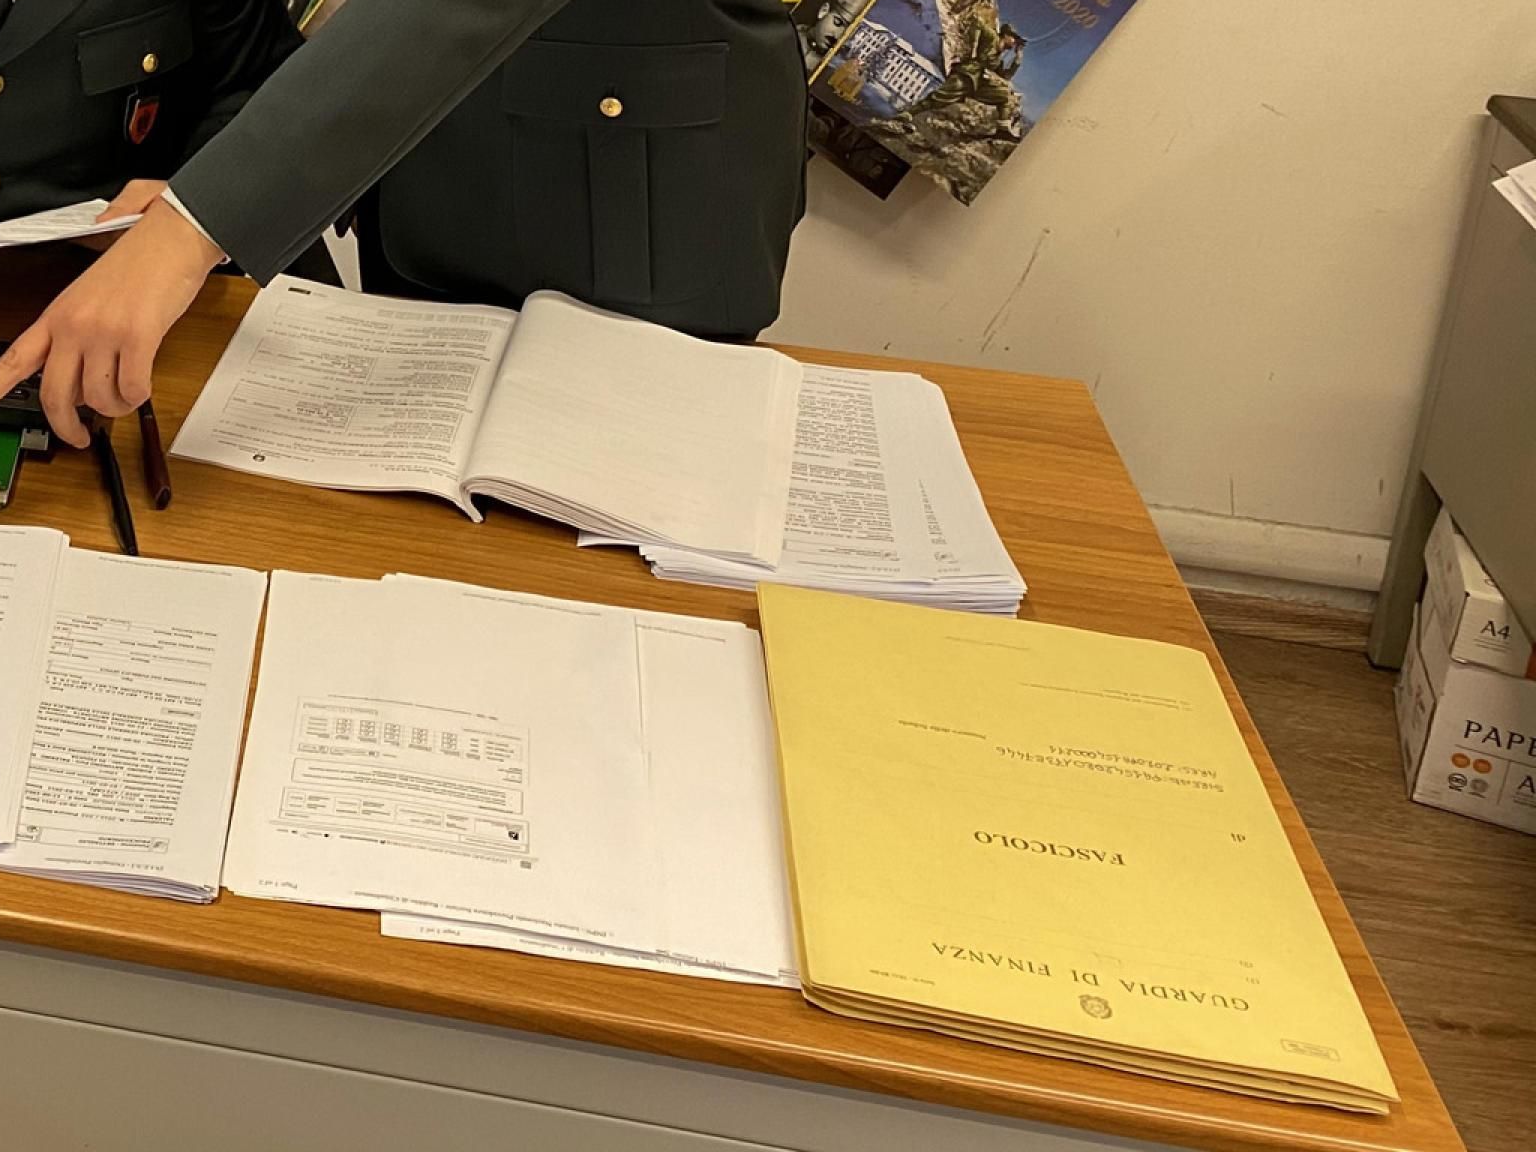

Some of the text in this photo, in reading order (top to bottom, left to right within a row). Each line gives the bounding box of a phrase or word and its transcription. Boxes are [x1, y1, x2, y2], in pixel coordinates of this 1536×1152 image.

[1480, 620, 1512, 639] A4
[973, 831, 1125, 866] FASCICOLO
[931, 942, 1052, 977] FINANZA
[1070, 970, 1100, 986] DI
[1119, 979, 1249, 1011] GUARDIA
